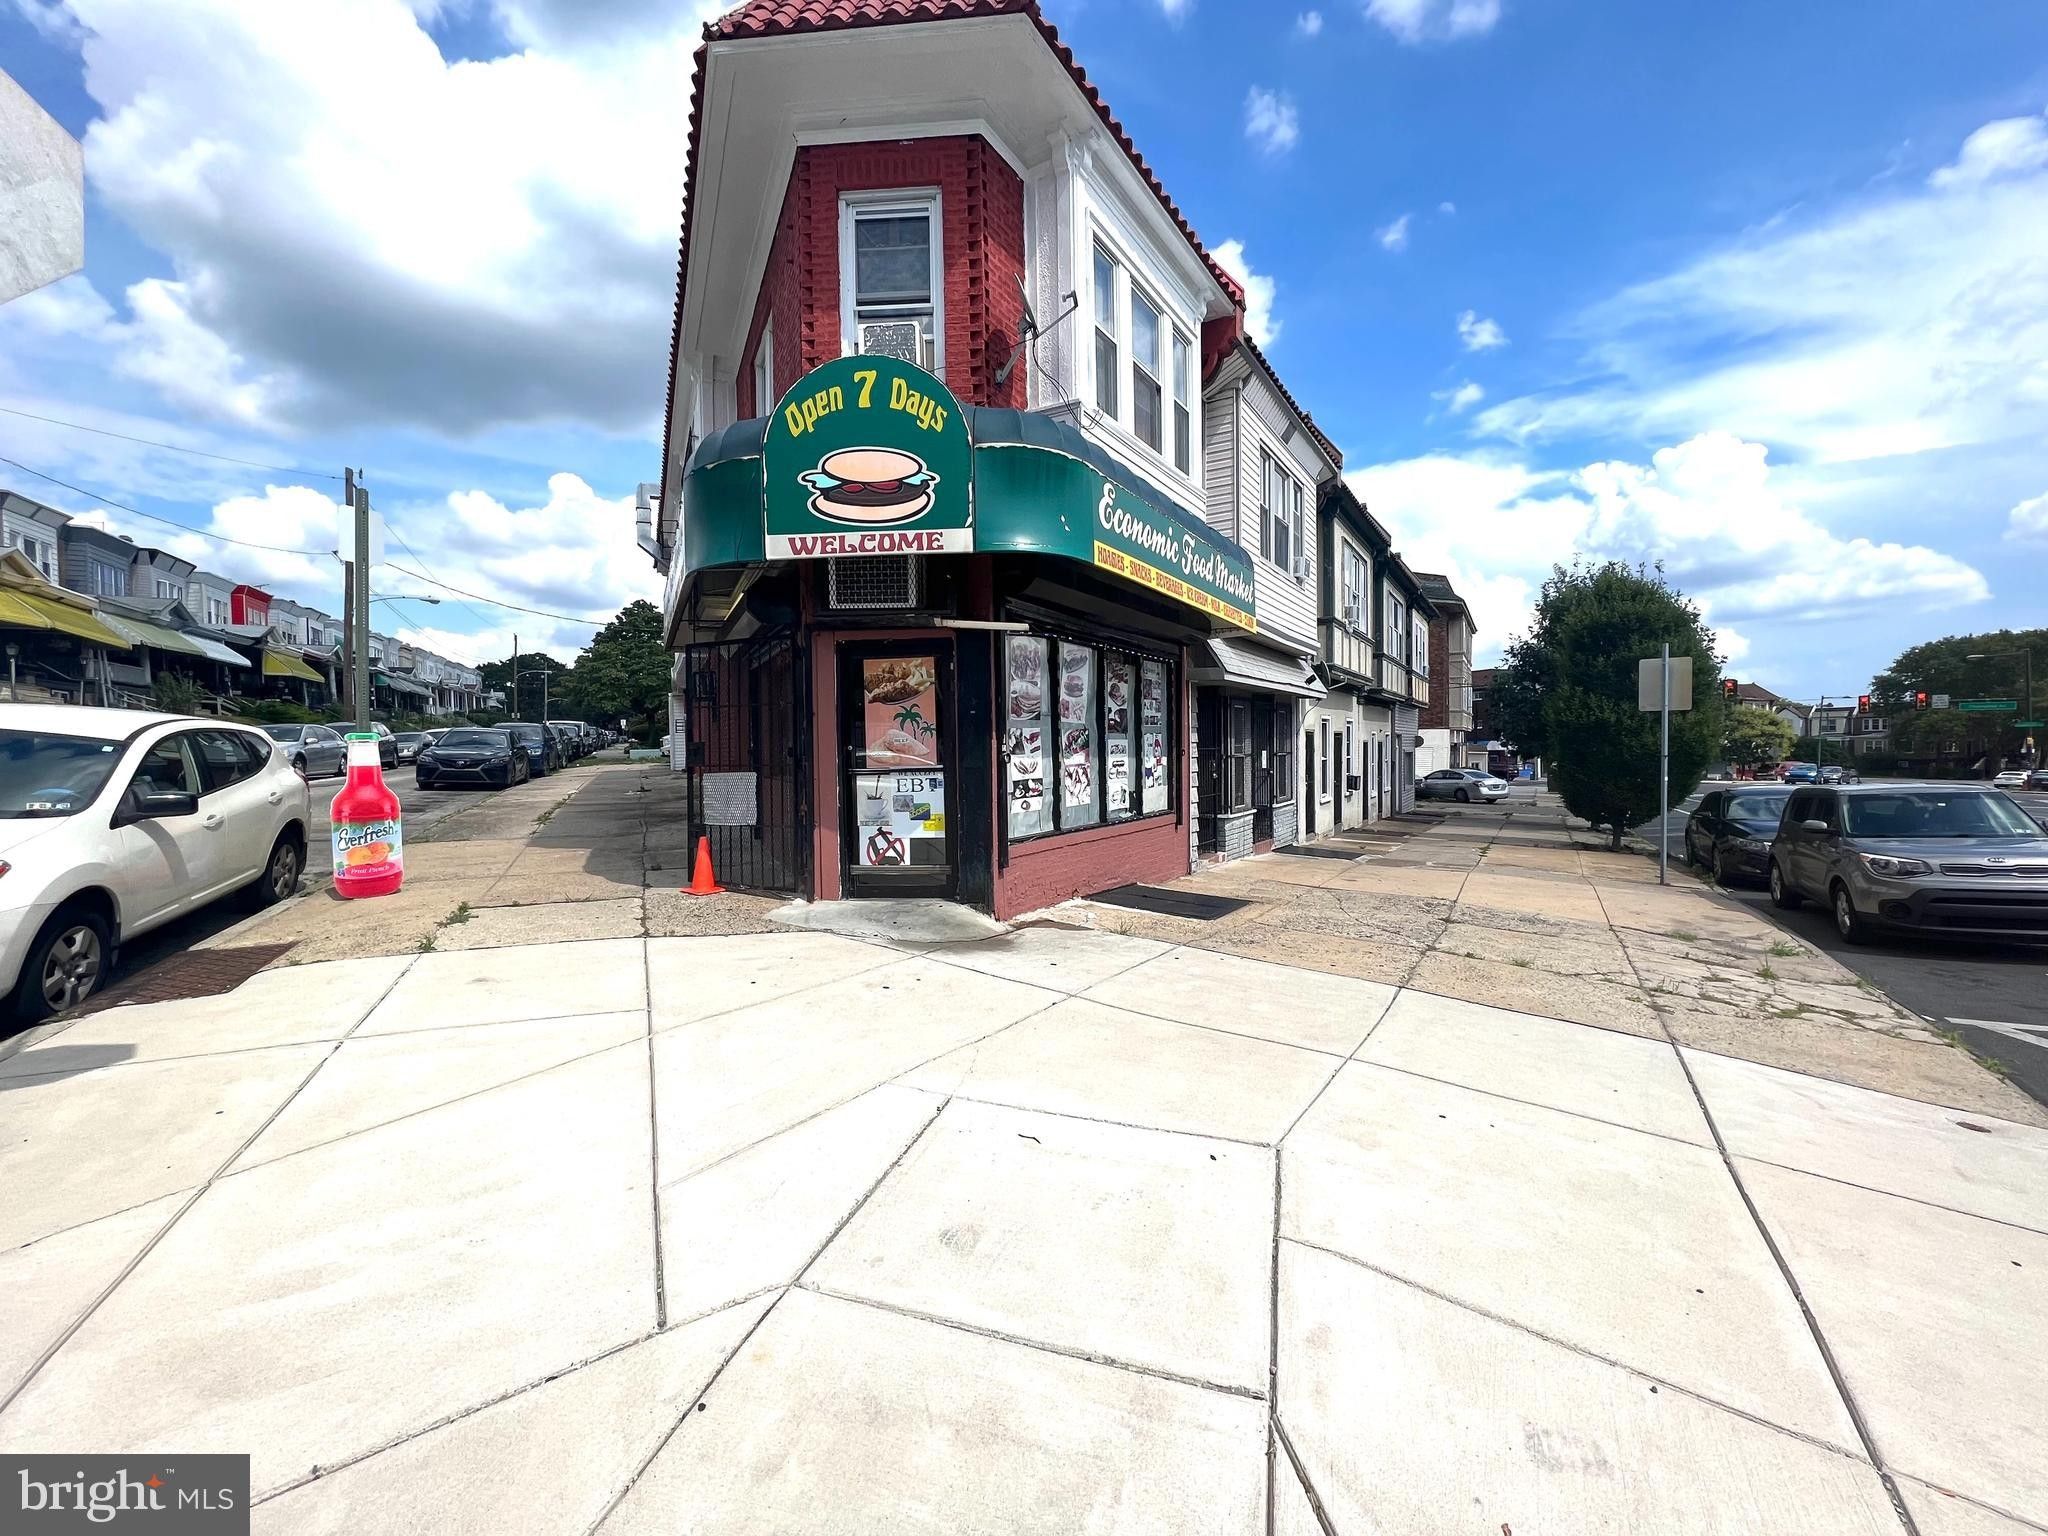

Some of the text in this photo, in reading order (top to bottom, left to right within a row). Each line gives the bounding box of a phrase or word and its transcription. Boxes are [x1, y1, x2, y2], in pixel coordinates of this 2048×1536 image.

[785, 370, 948, 437] Open 7 Days
[787, 532, 944, 556] WELCOME
[1098, 482, 1254, 605] Economic Food Market
[1097, 545, 1125, 572] HOAGIES
[1129, 559, 1152, 583] SNACKS
[337, 821, 394, 852] Everfresh
